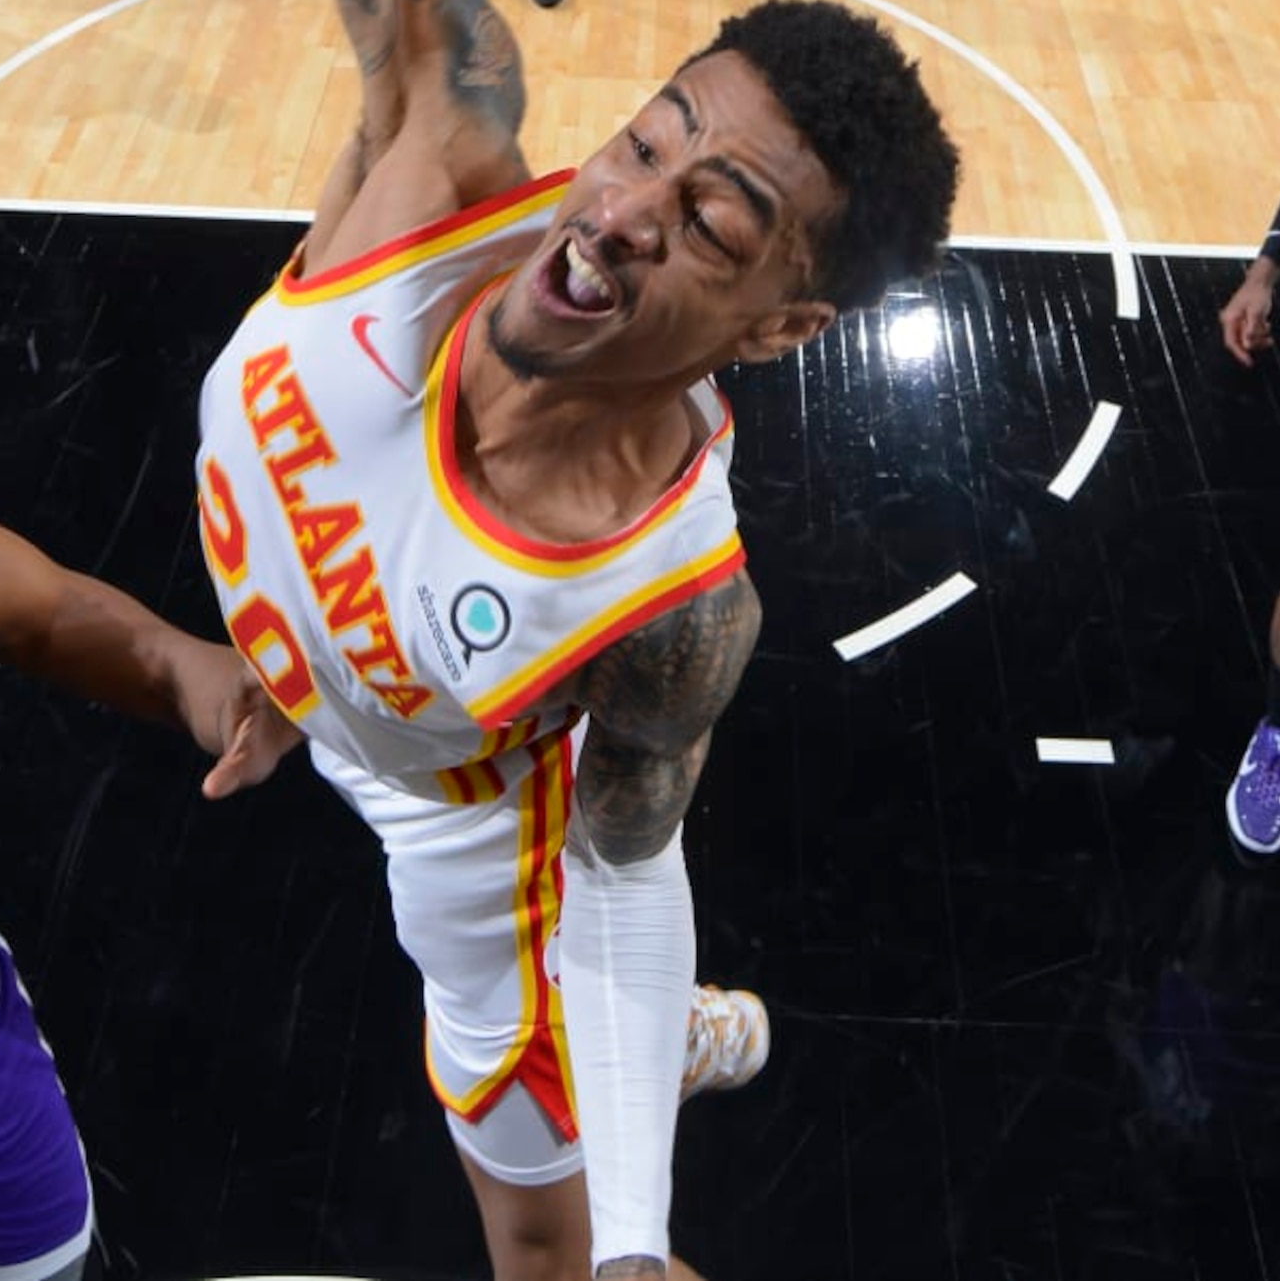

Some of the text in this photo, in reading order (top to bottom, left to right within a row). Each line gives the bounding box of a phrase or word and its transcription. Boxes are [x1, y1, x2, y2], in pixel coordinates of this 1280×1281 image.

[198, 453, 322, 724] 20
[241, 341, 440, 722] ATLANTA
[417, 584, 462, 682] sharecare
